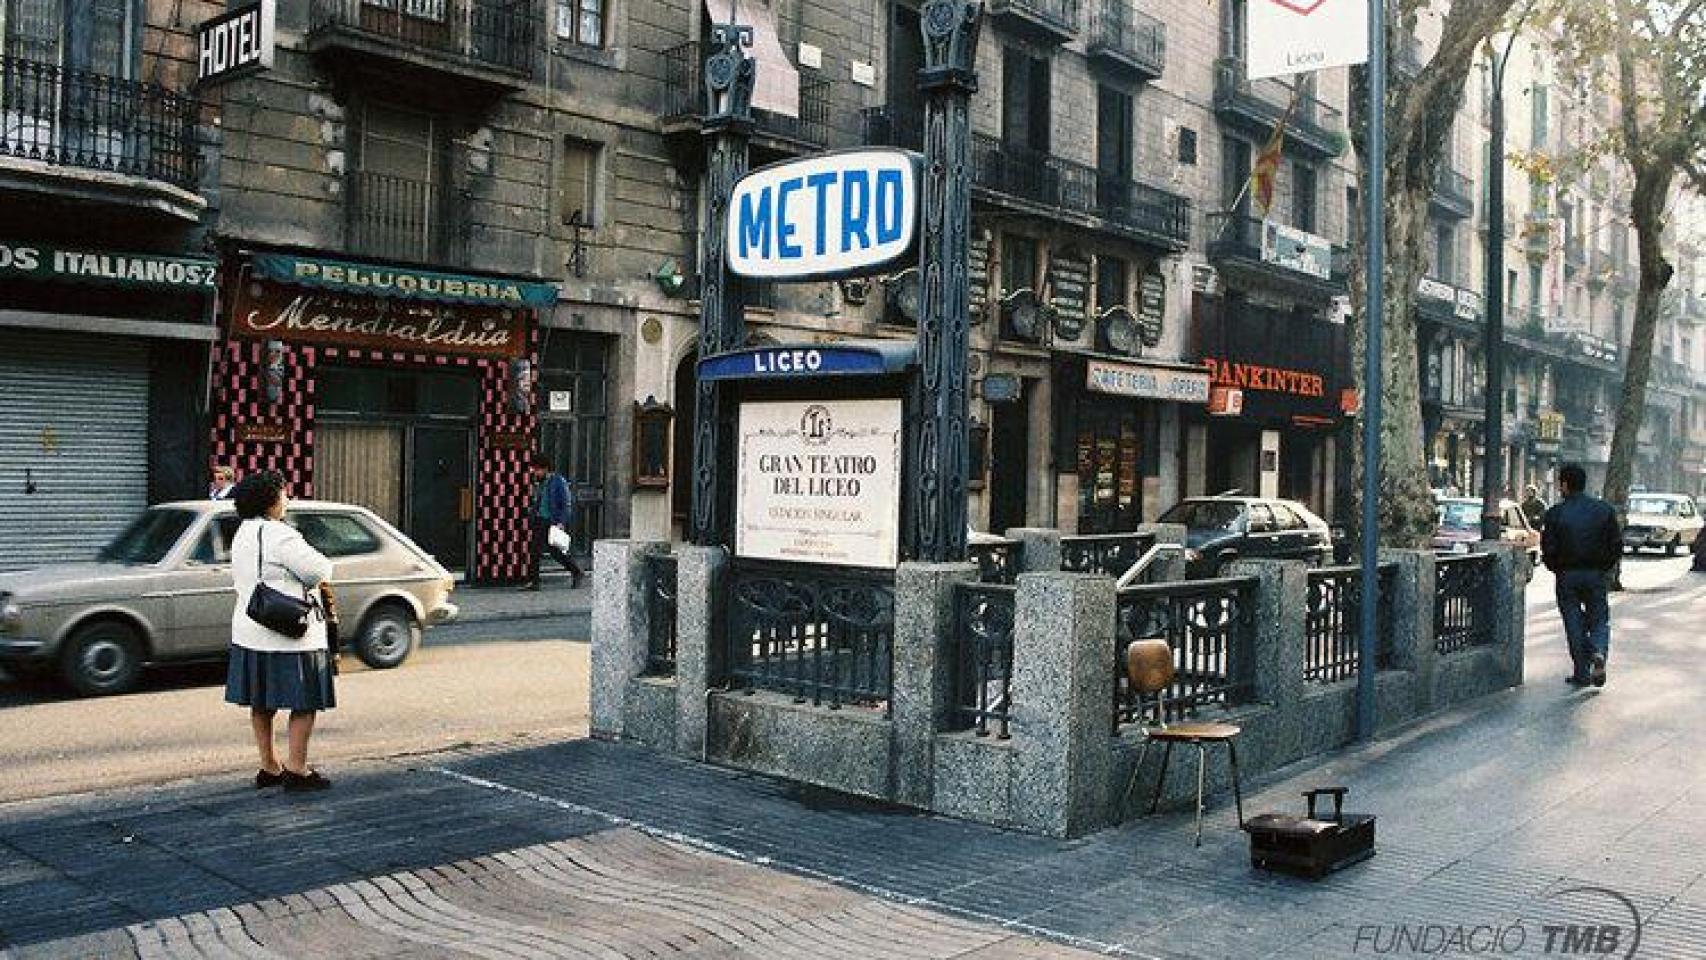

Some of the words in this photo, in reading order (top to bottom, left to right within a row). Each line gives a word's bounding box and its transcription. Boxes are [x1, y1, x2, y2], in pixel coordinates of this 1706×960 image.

[200, 10, 260, 78] HOTEL
[738, 168, 904, 260] METRO
[295, 263, 522, 300] PELUQUERIA
[754, 350, 823, 373] LICEO
[1203, 358, 1323, 396] BANKINTER
[759, 454, 804, 474] GRAN
[807, 454, 877, 475] TEATRO
[773, 477, 804, 495] DEL
[809, 477, 861, 497] LICEO
